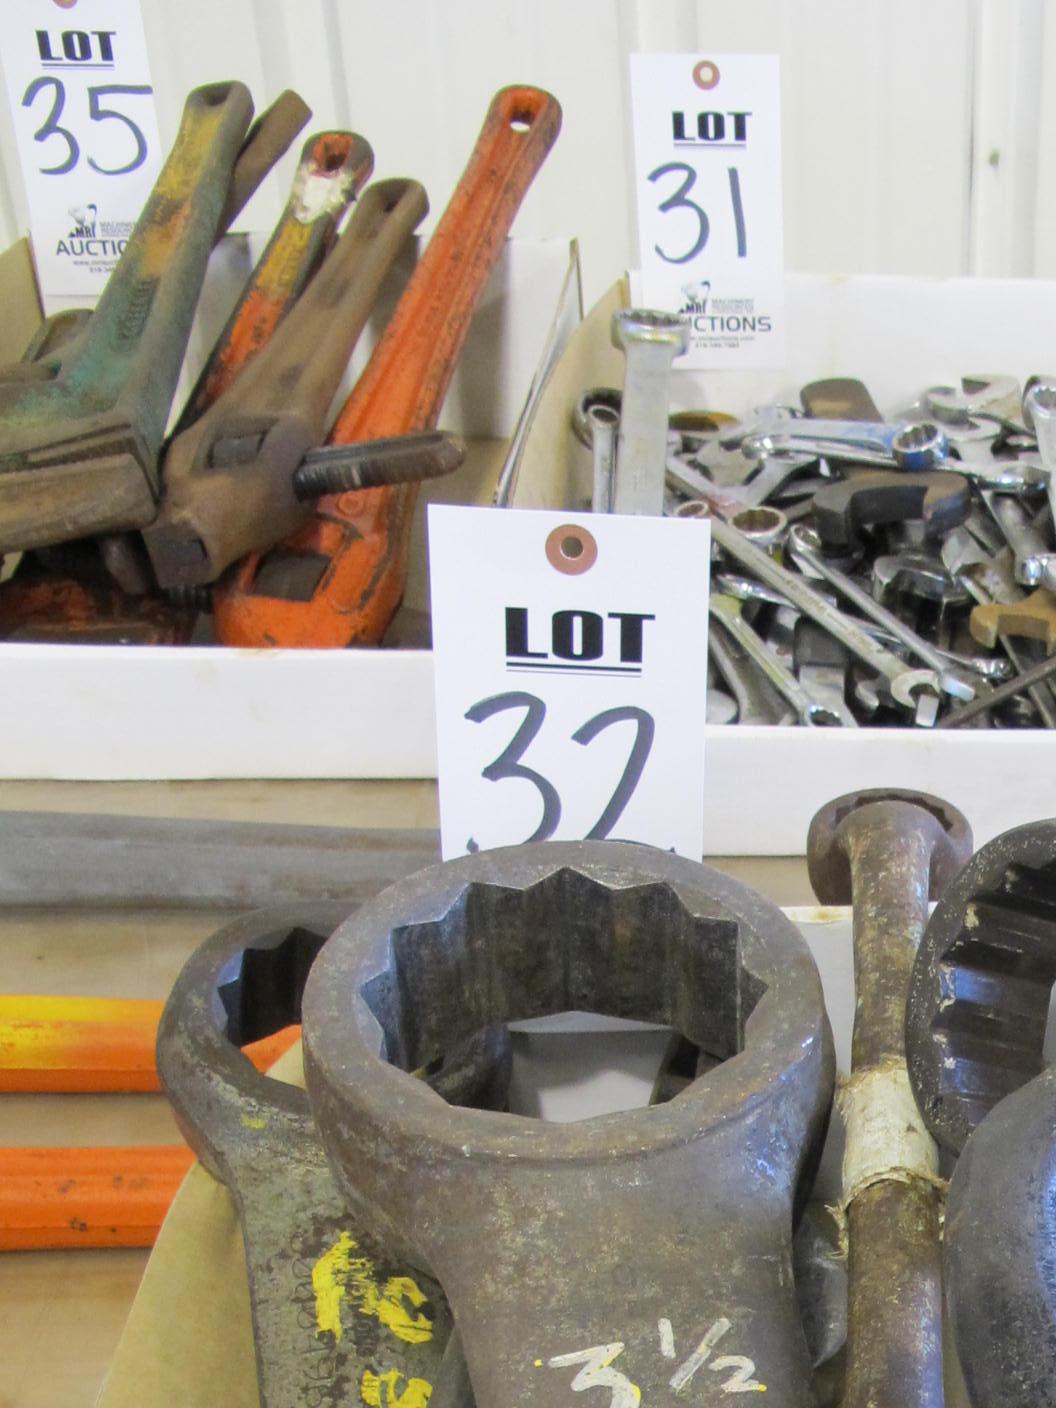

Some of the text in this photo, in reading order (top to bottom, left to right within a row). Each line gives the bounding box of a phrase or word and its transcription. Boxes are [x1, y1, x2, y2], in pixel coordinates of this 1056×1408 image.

[35, 30, 117, 61] LOT
[22, 76, 153, 176] 35
[672, 111, 752, 141] LOT
[647, 161, 747, 265] 31
[688, 316, 772, 332] CTIONS
[504, 606, 656, 663] LOT
[657, 1316, 768, 1397] 1/2
